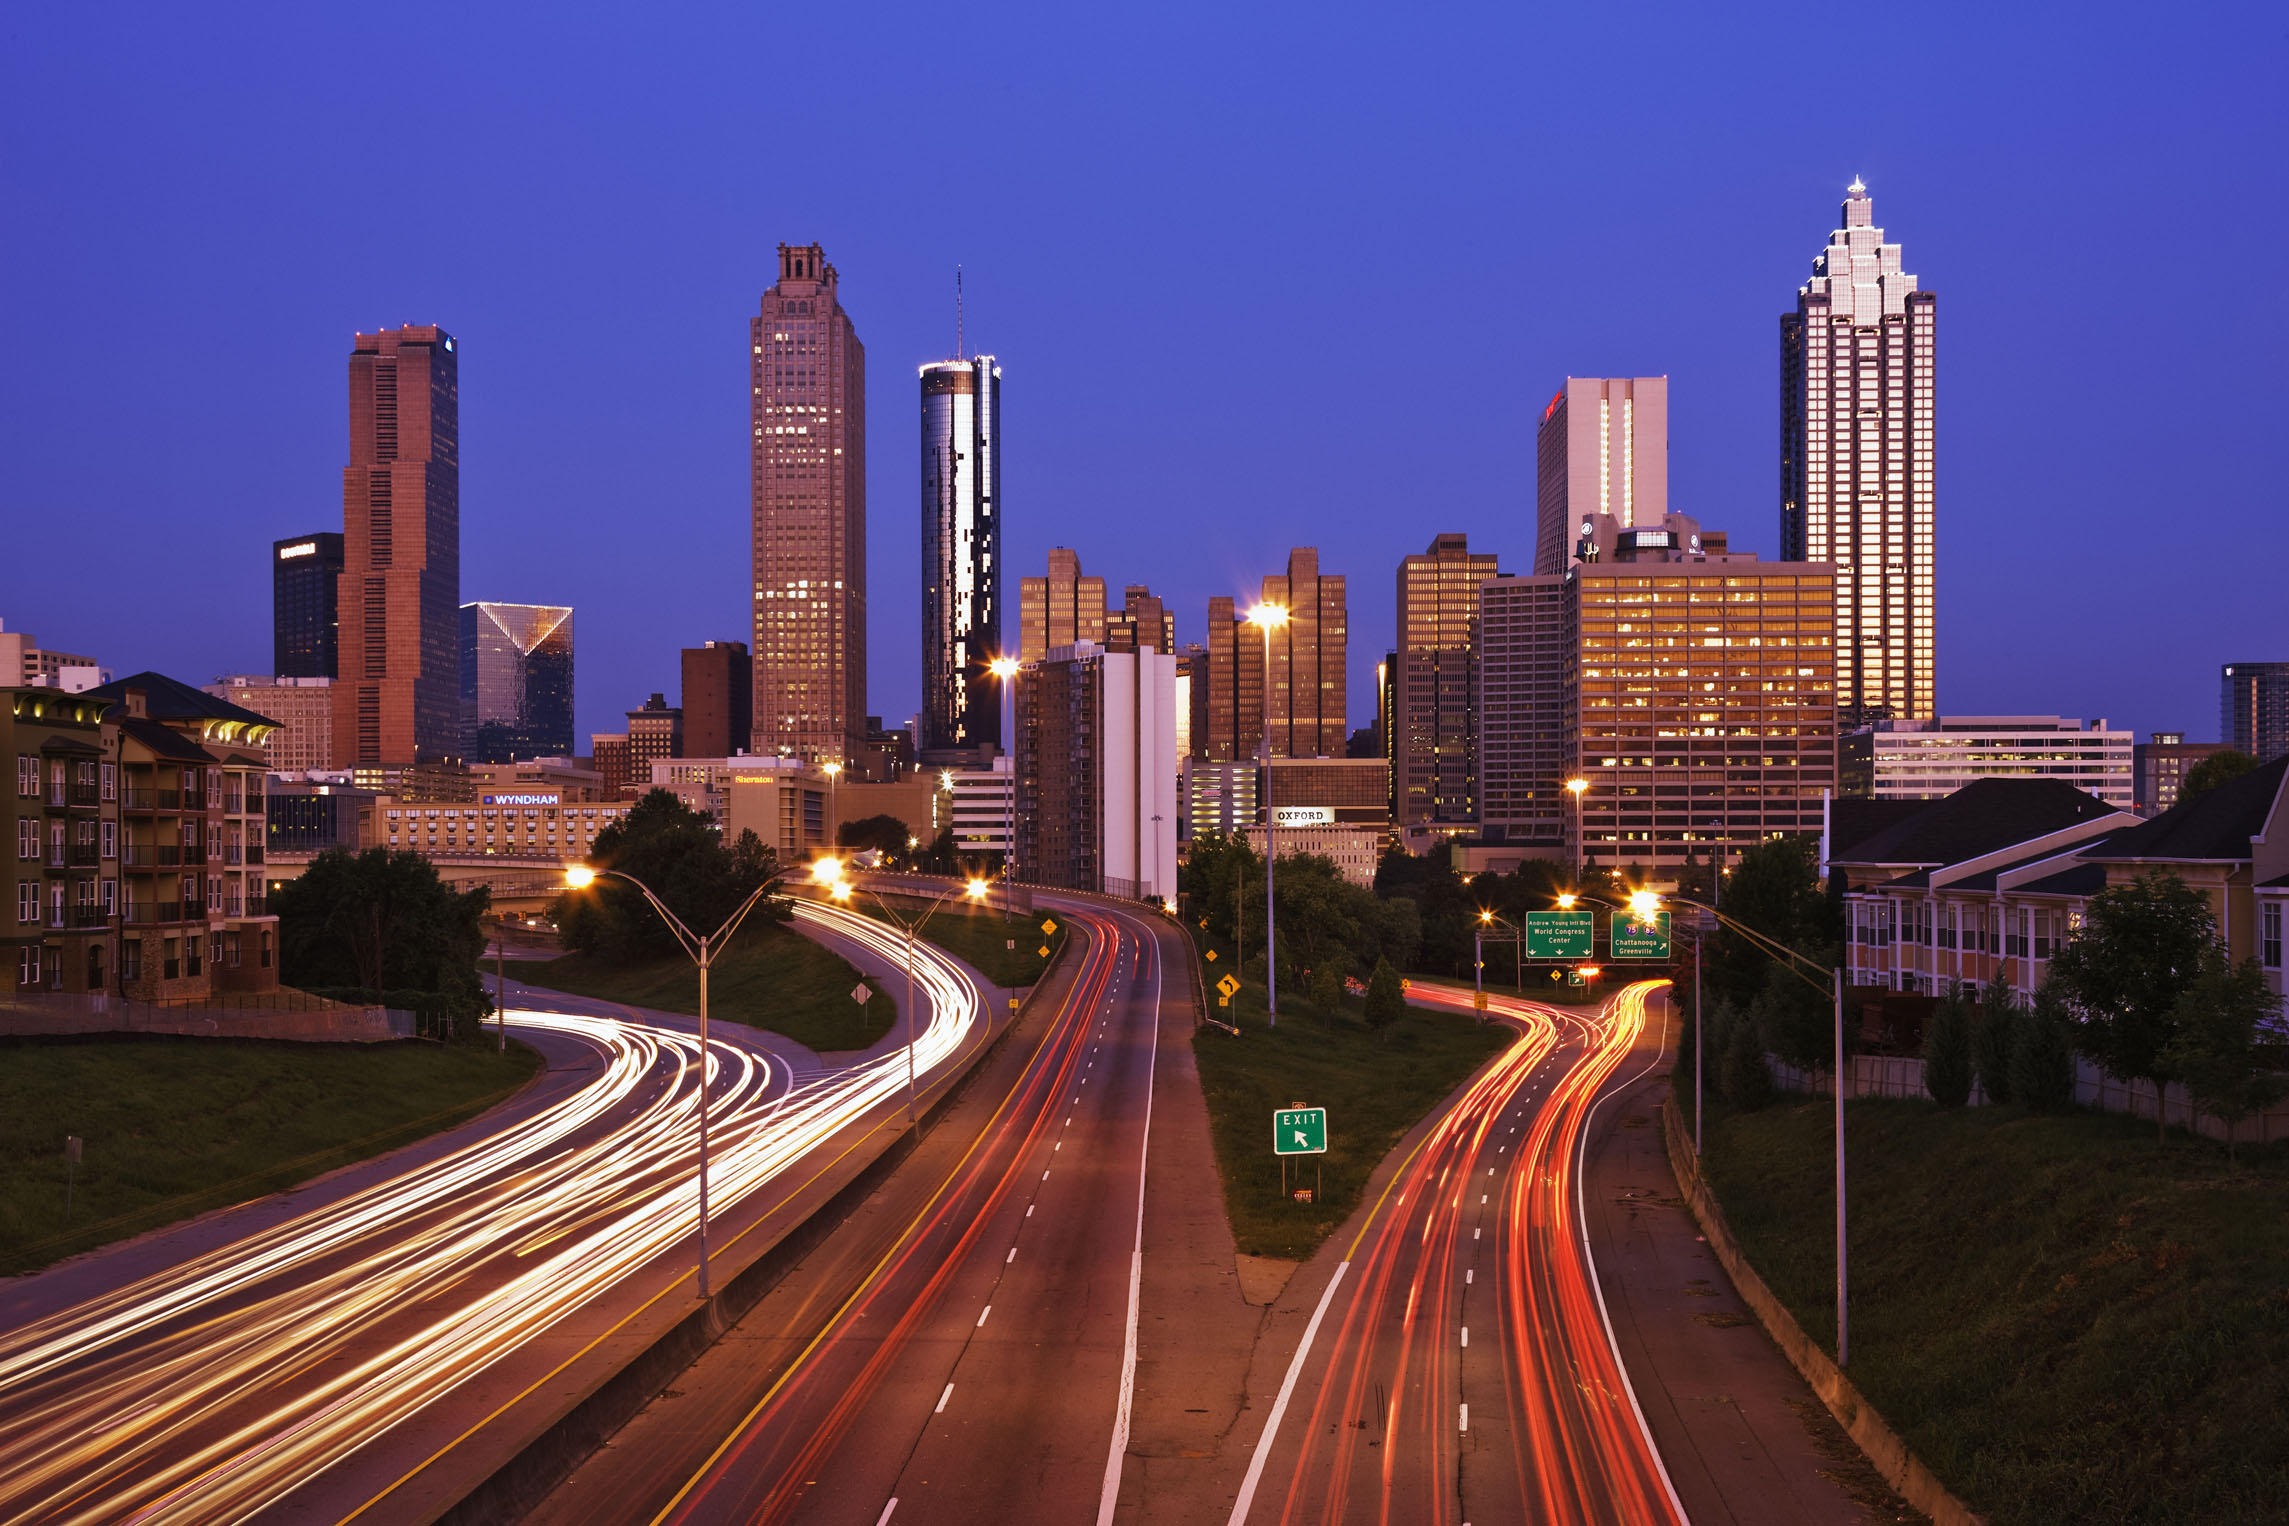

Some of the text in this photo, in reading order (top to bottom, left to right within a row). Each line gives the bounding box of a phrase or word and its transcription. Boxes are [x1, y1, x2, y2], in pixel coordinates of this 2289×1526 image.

[735, 775, 774, 784] Sheraton
[495, 795, 558, 805] WYNDHAM
[1278, 811, 1323, 820] OXFORD
[1554, 928, 1585, 936] Congress
[1283, 1113, 1317, 1126] EXIT
